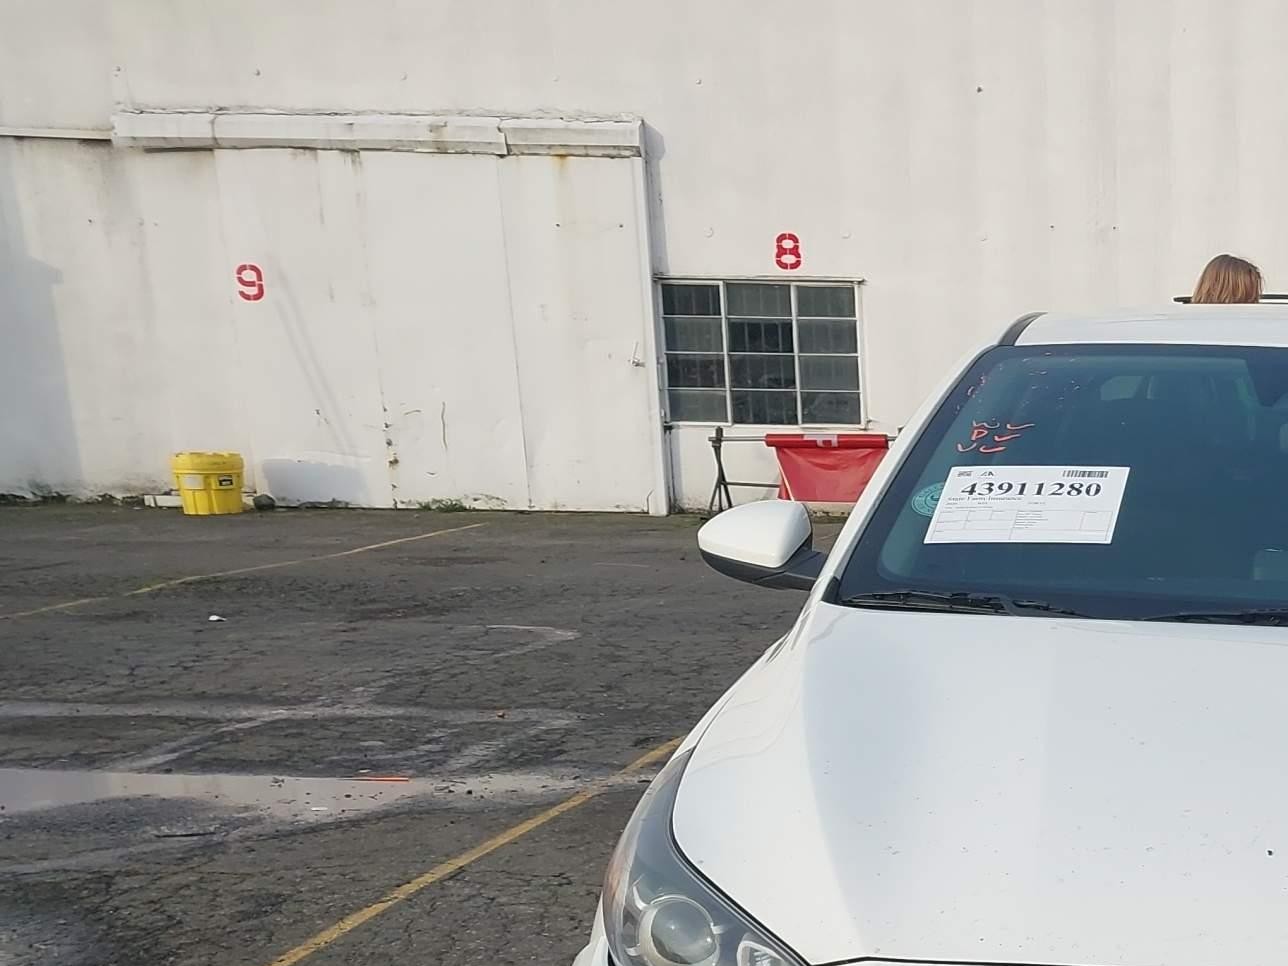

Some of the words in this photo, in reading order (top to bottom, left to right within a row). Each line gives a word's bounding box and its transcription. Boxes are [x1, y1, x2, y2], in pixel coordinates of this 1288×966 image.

[775, 233, 802, 270] 8
[236, 264, 265, 301] 9
[960, 482, 1102, 497] 43911280
